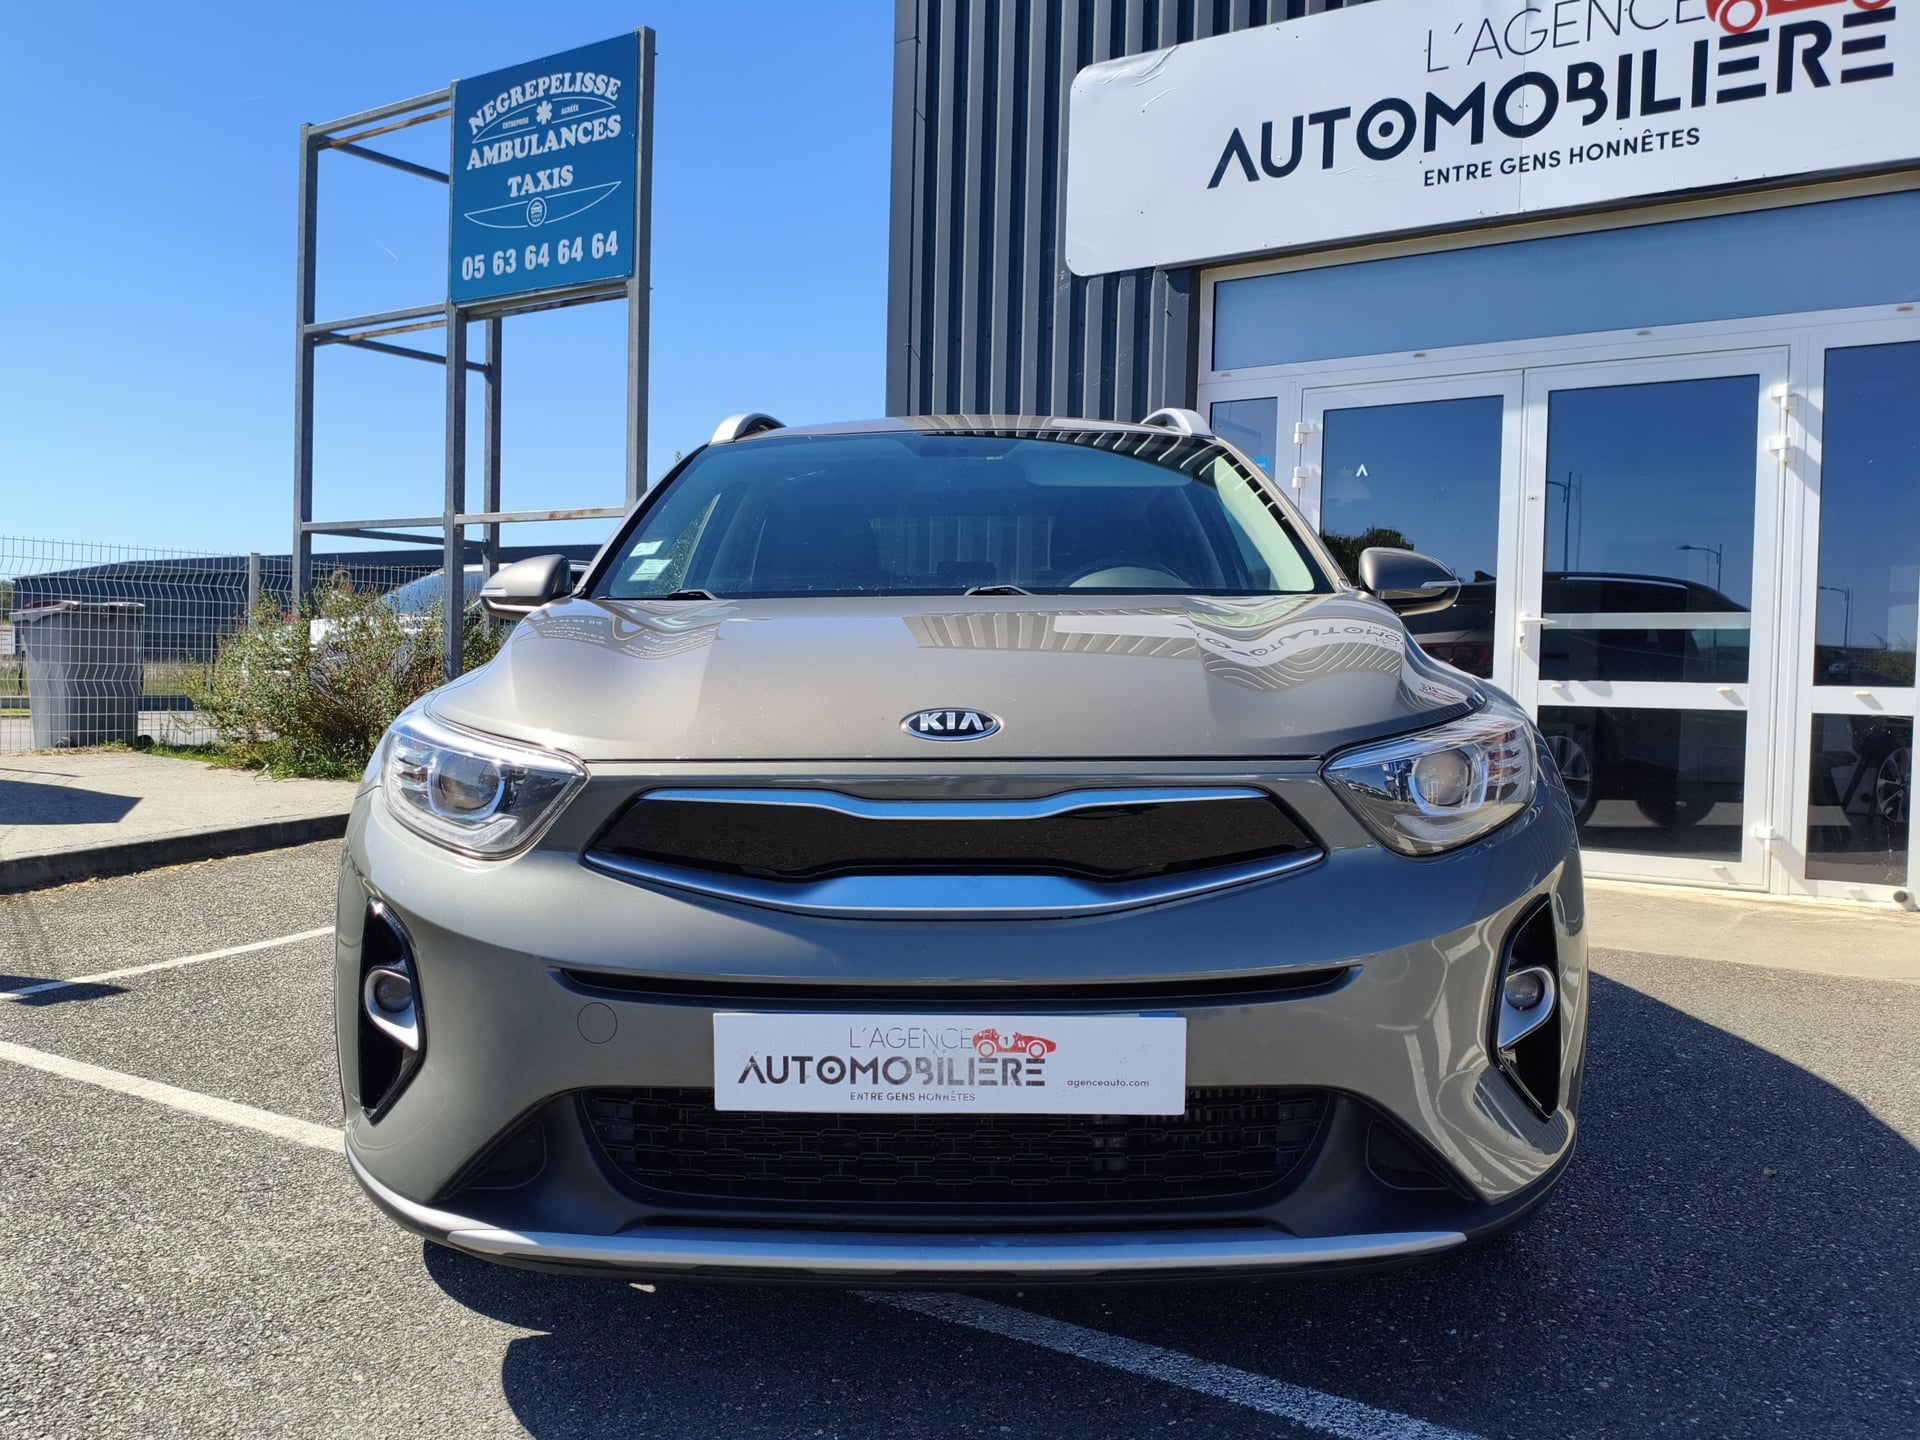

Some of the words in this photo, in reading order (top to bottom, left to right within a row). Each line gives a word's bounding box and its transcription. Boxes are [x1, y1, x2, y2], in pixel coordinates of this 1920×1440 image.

[1427, 0, 1706, 73] L'AGENCE
[468, 72, 622, 135] NEGREPELISSE
[466, 114, 622, 171] AMBULANCES
[1424, 161, 1492, 187] ENTRE
[1500, 150, 1561, 176] GENS
[1569, 127, 1700, 165] HONNÊTES
[507, 165, 574, 198] TAXIS
[462, 254, 485, 280] 05
[492, 248, 517, 275] 63
[524, 242, 549, 270] 64
[558, 237, 583, 265] 64
[591, 230, 618, 259] 64
[919, 712, 984, 731] KIA
[850, 1027, 973, 1049] L'AGENCE
[1003, 1036, 1009, 1046] 1
[850, 1091, 884, 1101] ENTRE
[886, 1092, 915, 1101] GENS
[918, 1090, 976, 1101] HONNÊTES
[1067, 1079, 1150, 1089] agenceauto.com
